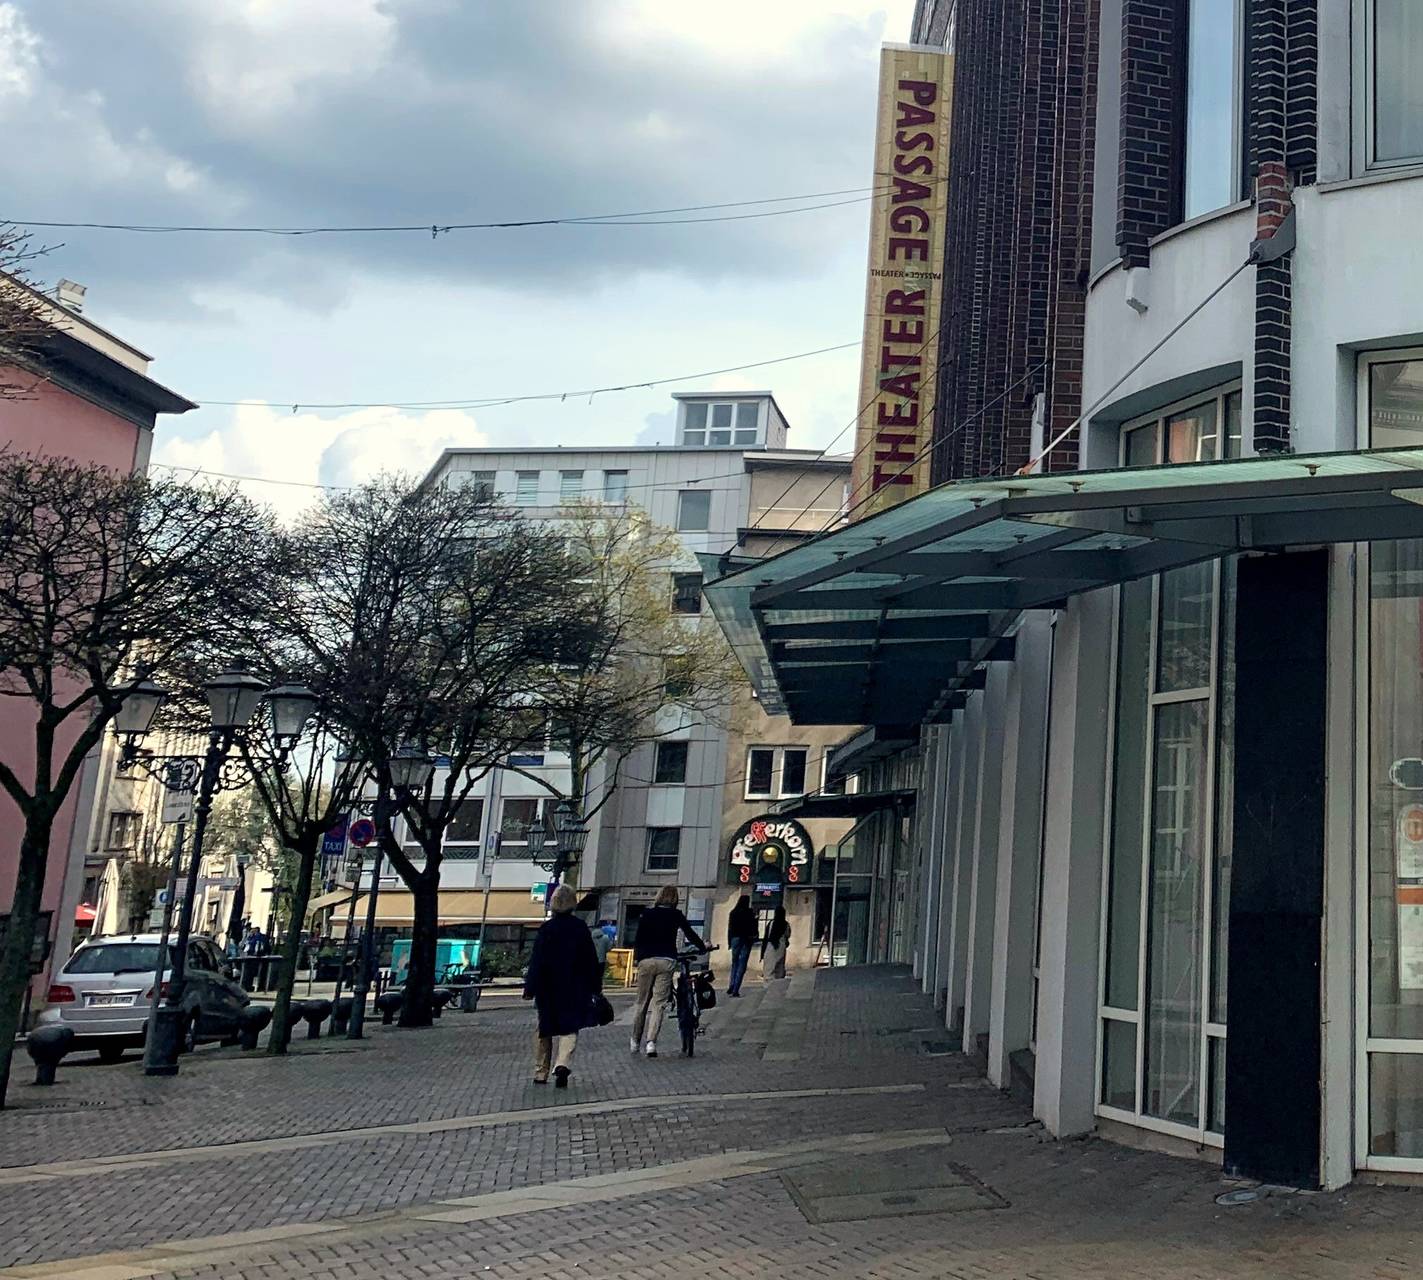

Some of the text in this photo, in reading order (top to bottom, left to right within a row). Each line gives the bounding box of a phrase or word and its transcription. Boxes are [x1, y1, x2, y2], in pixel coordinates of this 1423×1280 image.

[888, 80, 937, 262] PASSAGE
[871, 269, 904, 278] THEATER
[910, 271, 942, 280] PASSAGE
[872, 289, 926, 492] THEATER
[324, 841, 343, 851] TAXI
[731, 821, 808, 866] Pfefferkorn
